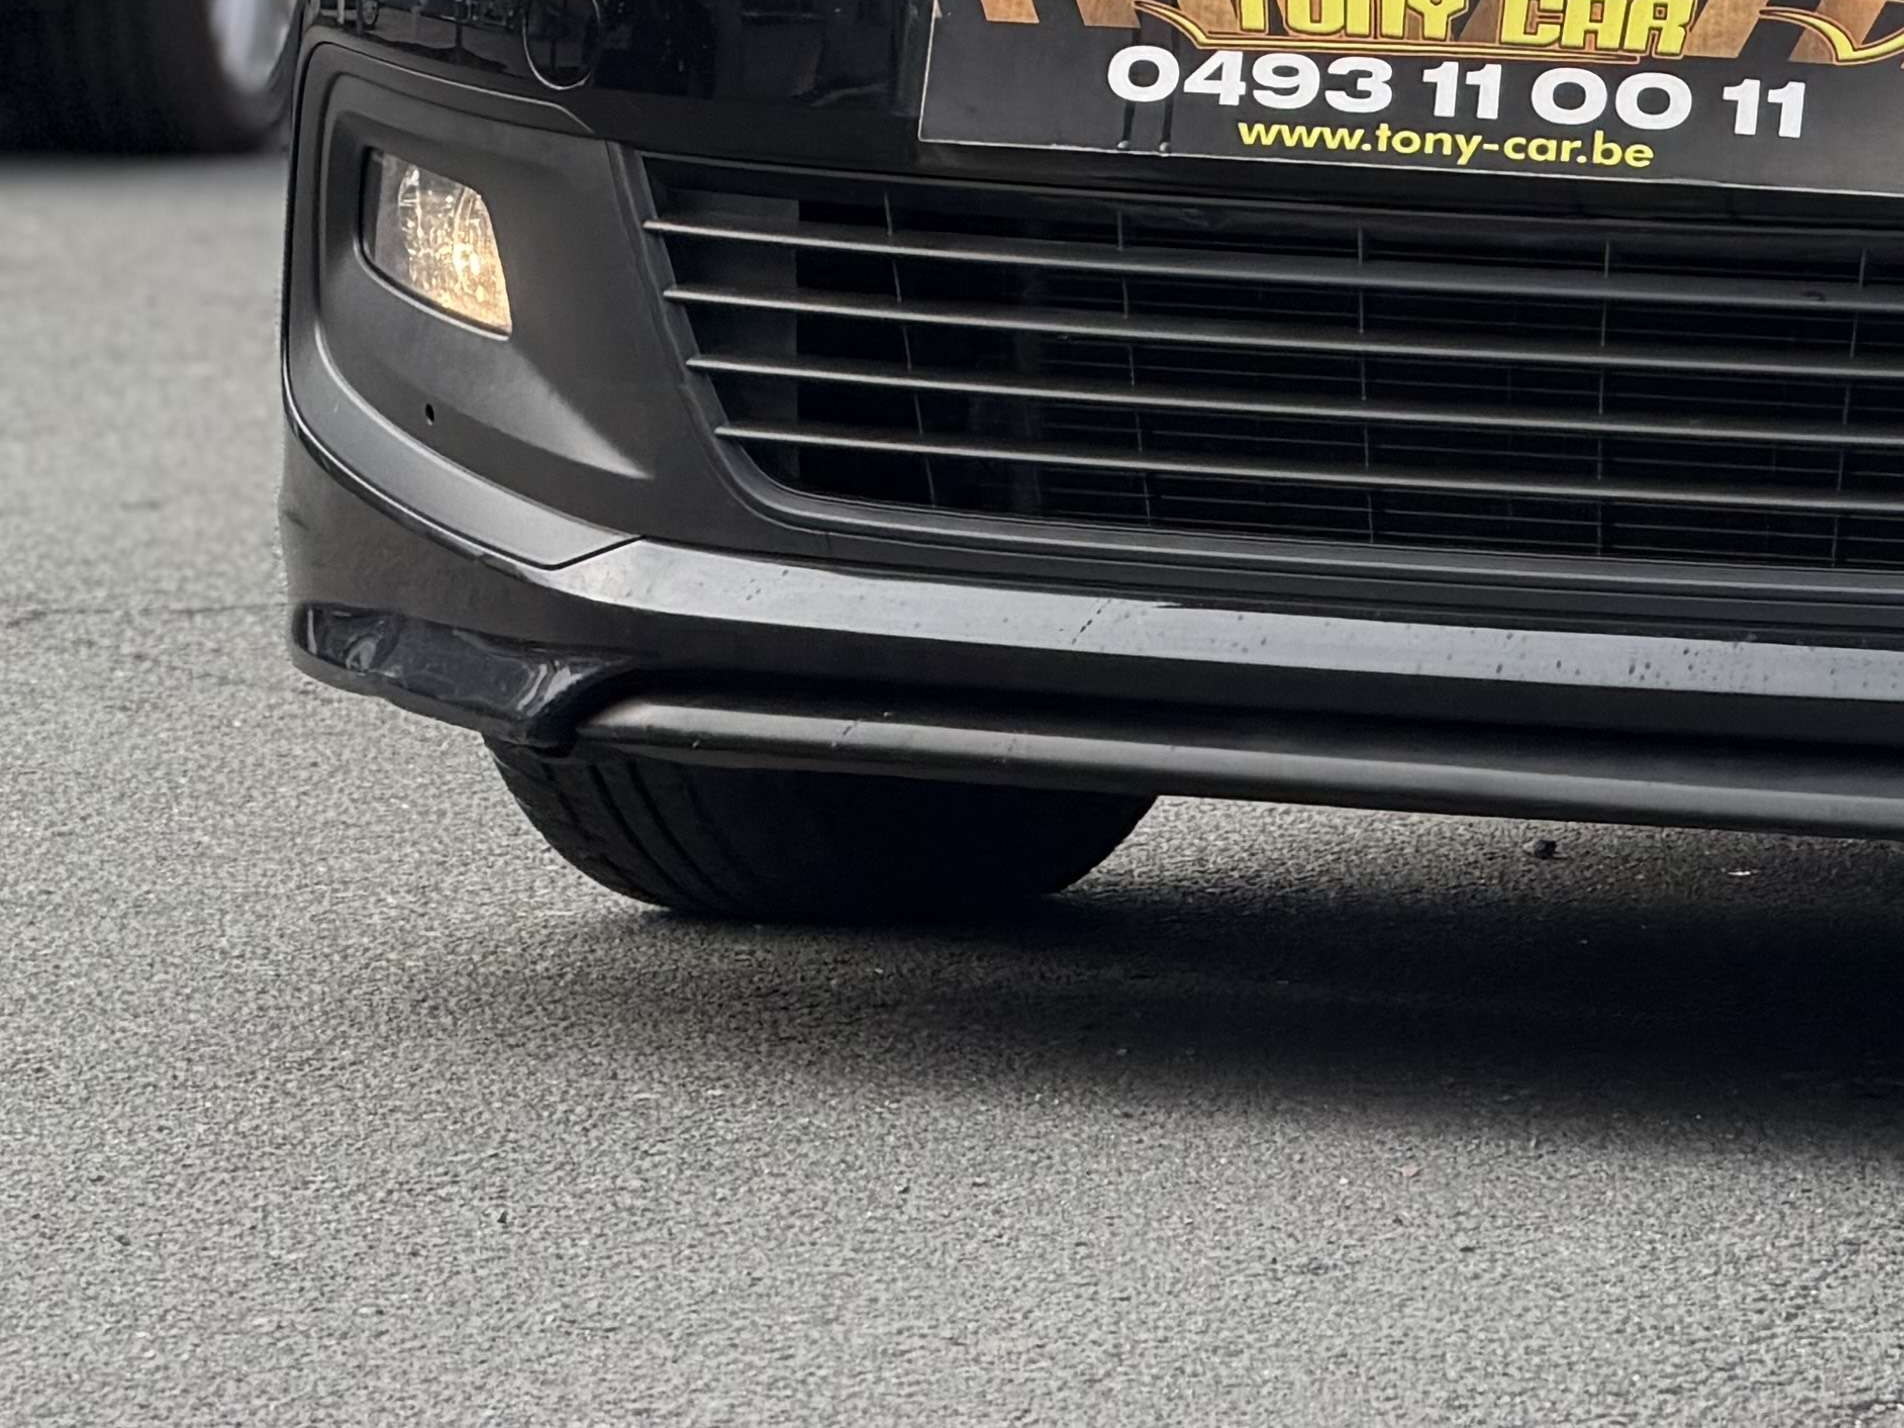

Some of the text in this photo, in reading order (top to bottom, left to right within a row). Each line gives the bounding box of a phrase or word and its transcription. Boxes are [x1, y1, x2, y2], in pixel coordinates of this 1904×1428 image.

[1107, 44, 1806, 138] 0493 11 00 11
[1237, 122, 1655, 168] www.tony-car.be
